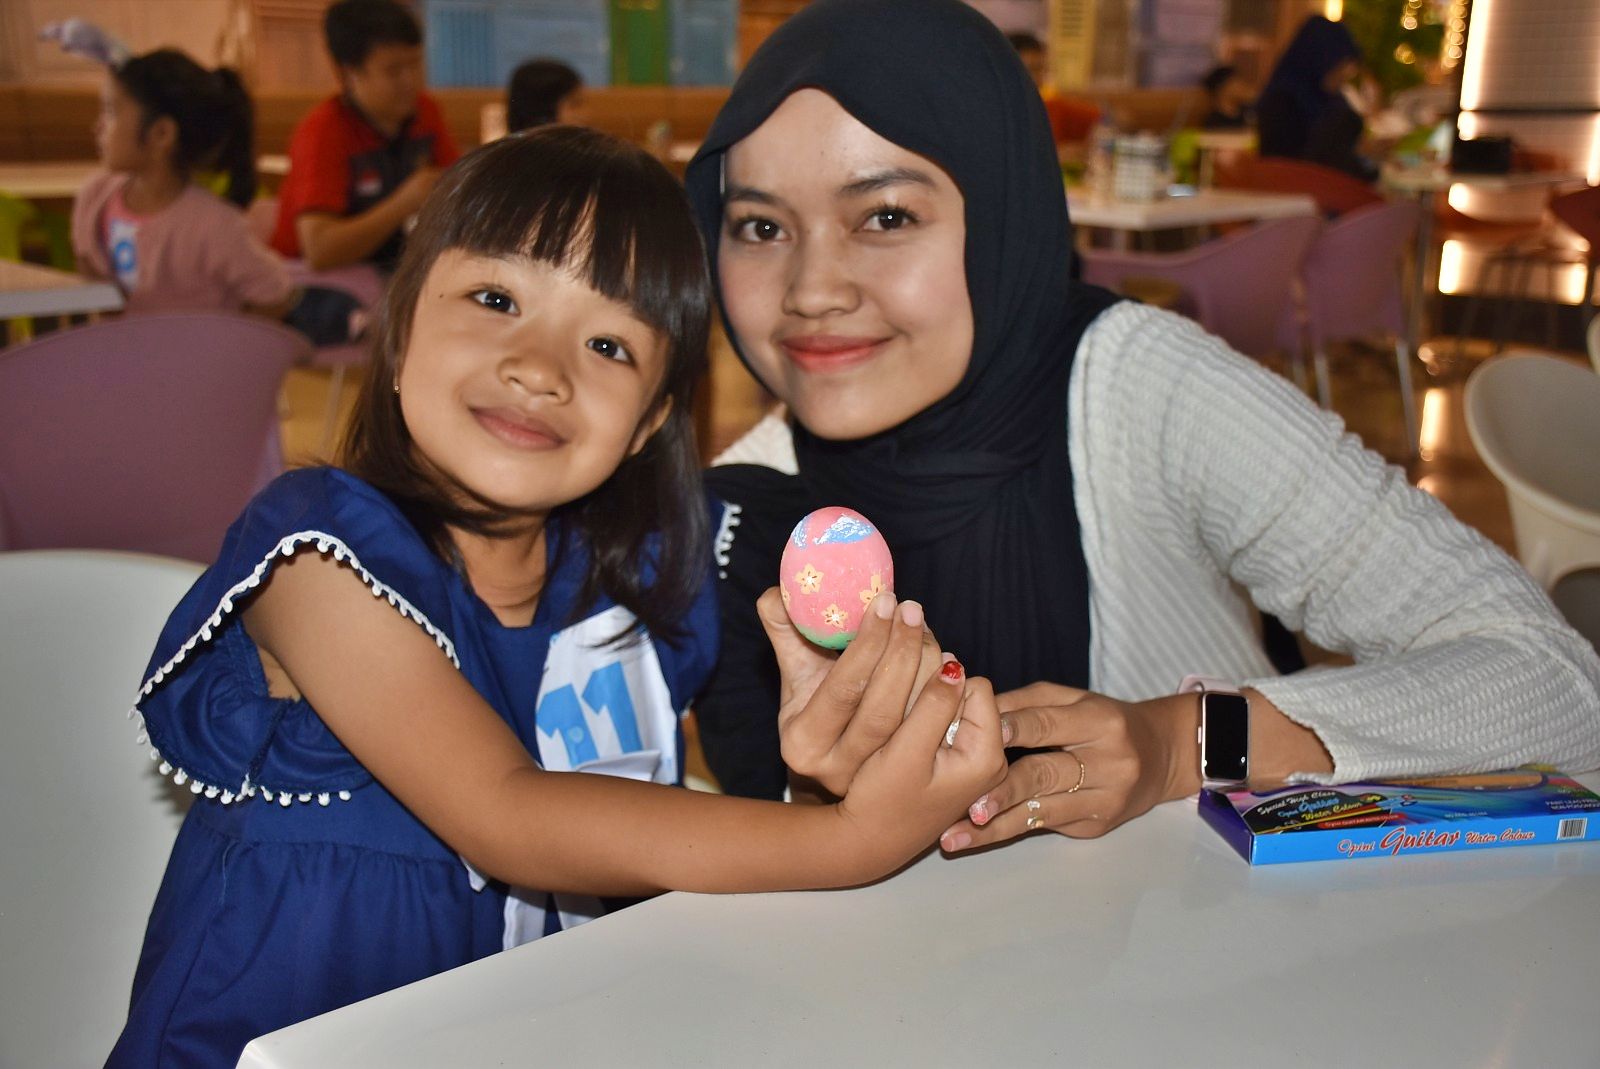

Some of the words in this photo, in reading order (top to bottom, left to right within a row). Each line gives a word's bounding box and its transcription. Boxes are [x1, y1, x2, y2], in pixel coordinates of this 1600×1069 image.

[537, 661, 643, 767] 11
[1337, 839, 1375, 857] Opini
[1379, 825, 1460, 856] Guitar
[1465, 831, 1497, 844] Water
[1500, 828, 1535, 841] Colour
